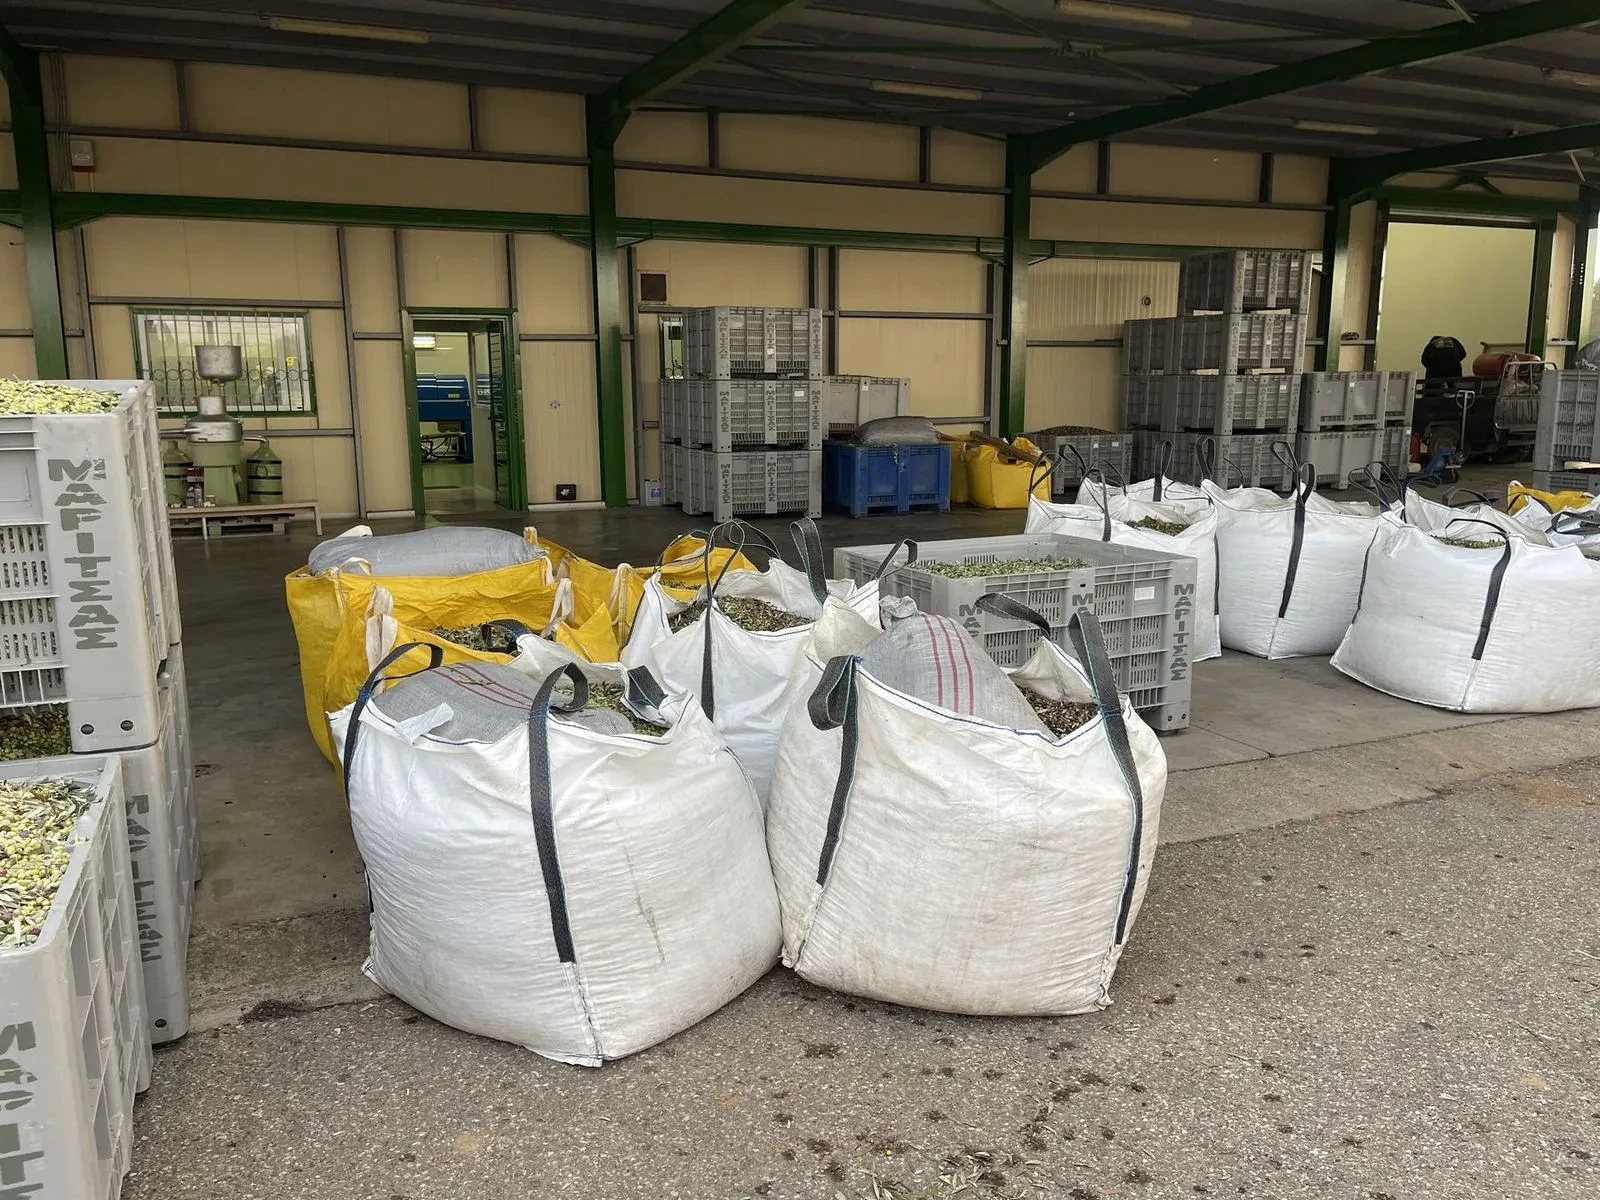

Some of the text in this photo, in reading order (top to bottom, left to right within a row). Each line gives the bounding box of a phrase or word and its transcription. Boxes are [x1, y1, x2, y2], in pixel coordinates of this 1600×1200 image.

[766, 317, 776, 360] ΜΑΡΙΤΣΣ
[48, 458, 119, 650] ΜΑΡΙΤΣΑΣ
[1169, 583, 1195, 681] ΜΑΡΙΤΣΑΣ
